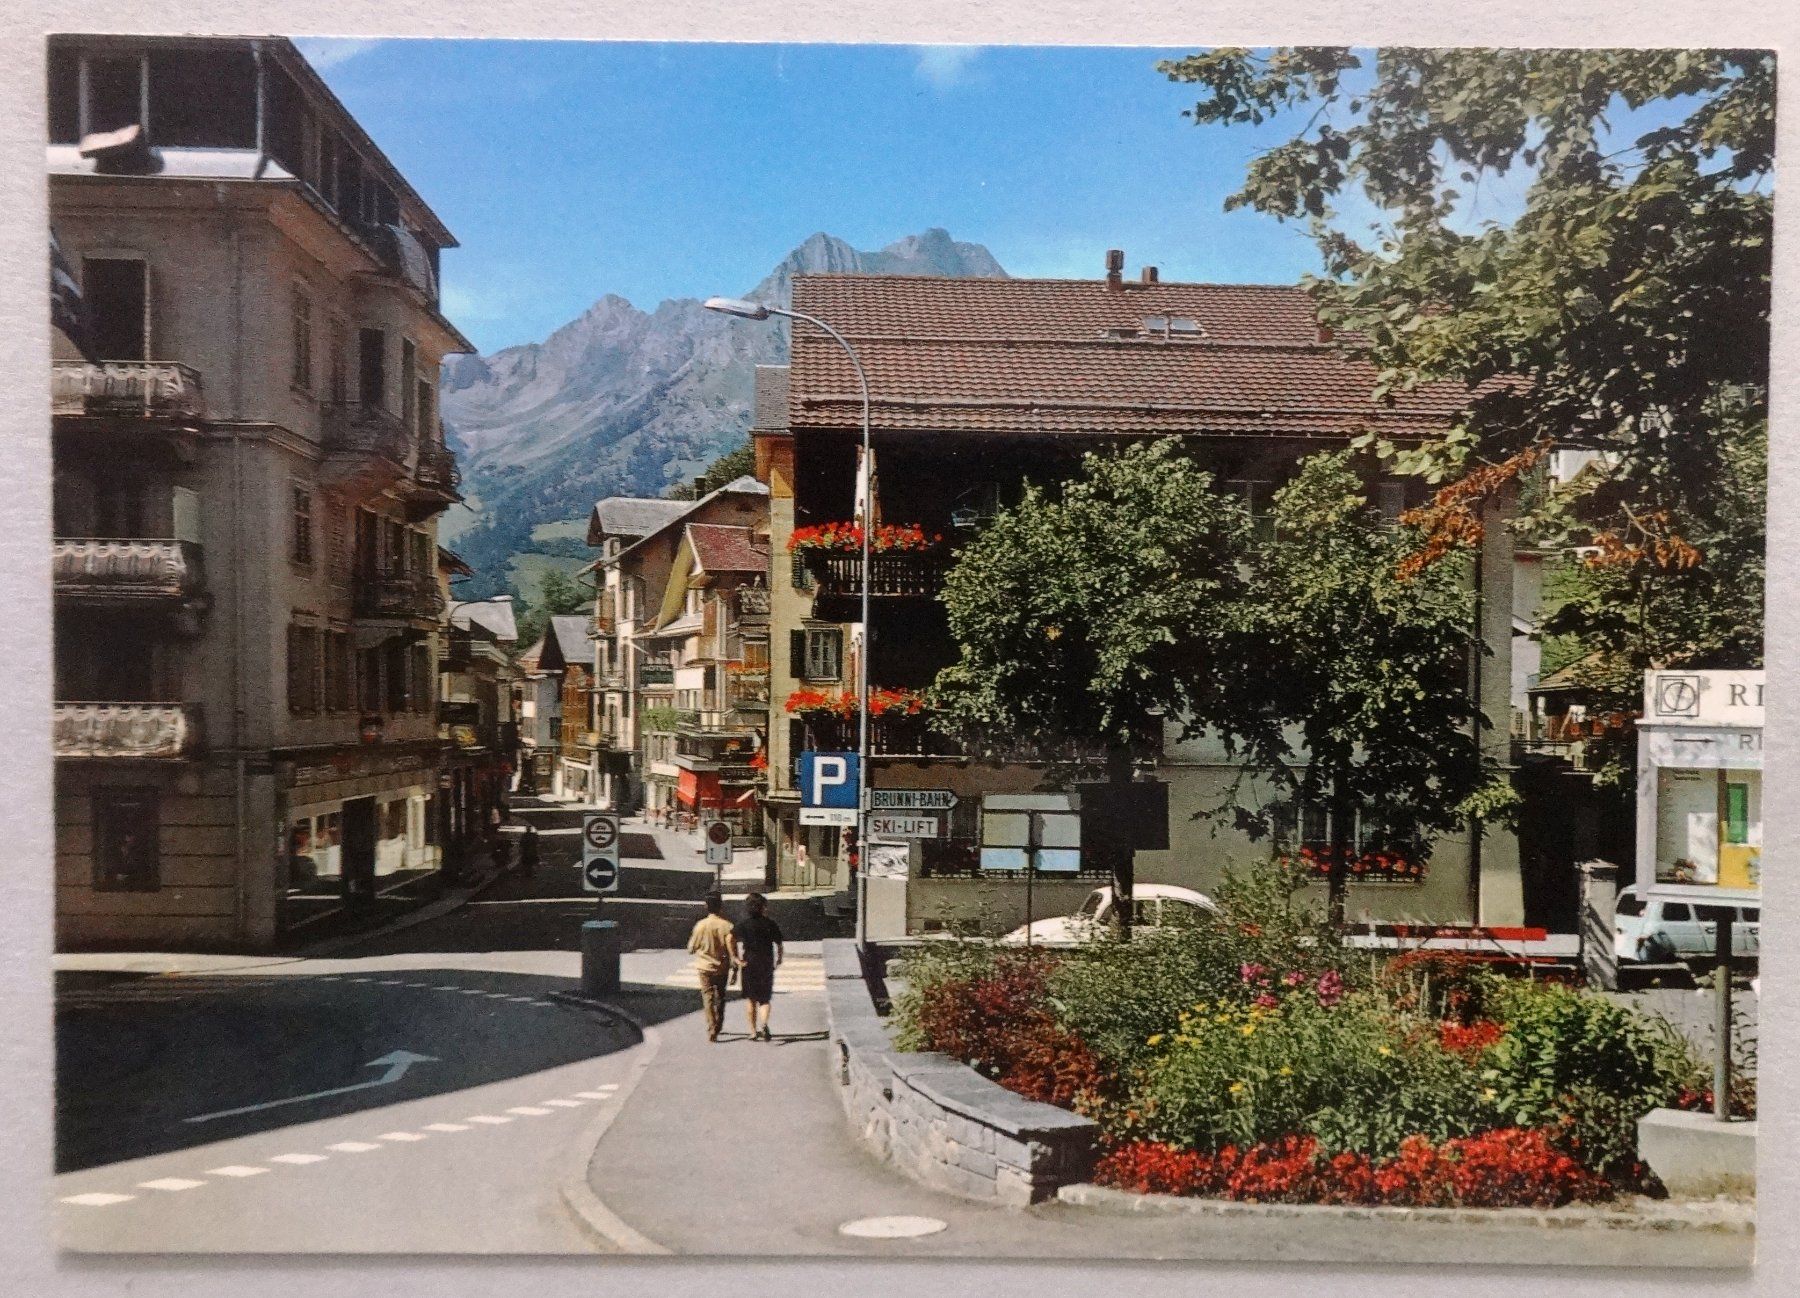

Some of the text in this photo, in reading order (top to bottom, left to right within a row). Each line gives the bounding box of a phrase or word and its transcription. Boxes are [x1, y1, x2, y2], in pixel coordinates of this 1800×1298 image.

[813, 756, 846, 805] P
[874, 790, 949, 807] BRUNNI-BAHN
[873, 819, 934, 834] SKI-LIFT
